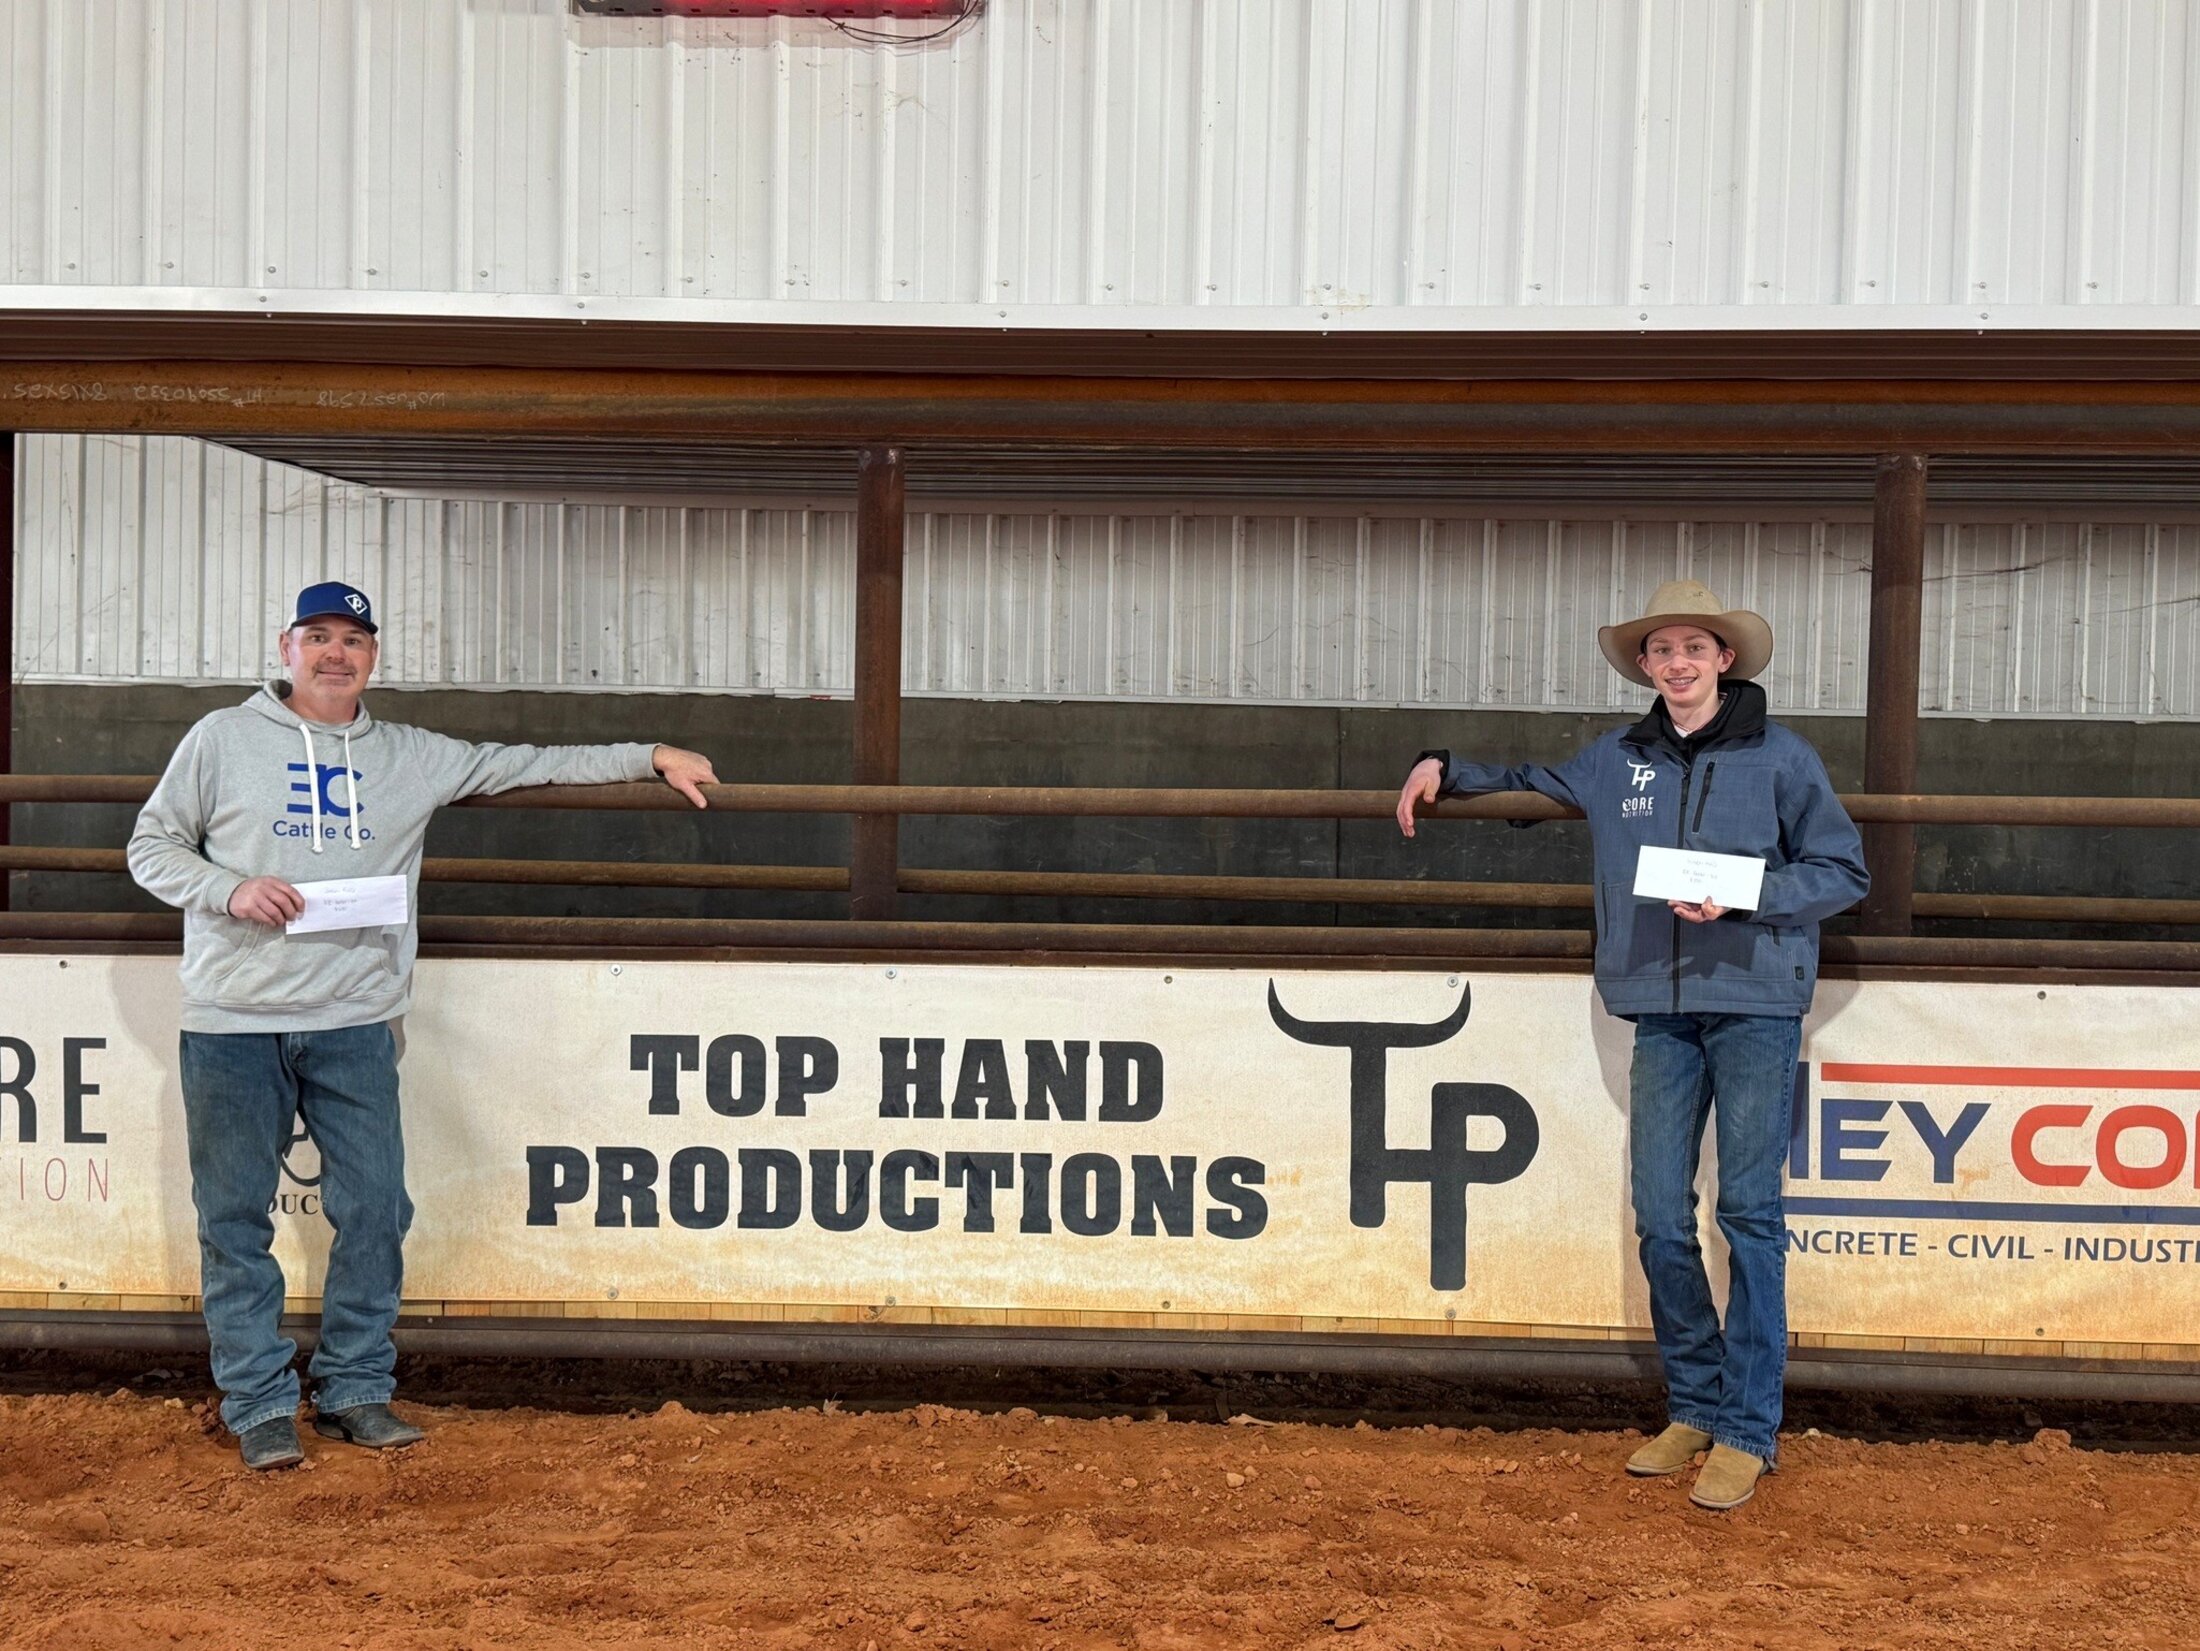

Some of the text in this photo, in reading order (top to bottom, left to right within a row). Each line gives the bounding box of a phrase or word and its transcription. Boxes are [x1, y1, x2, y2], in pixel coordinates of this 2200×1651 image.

[1622, 796, 1655, 812] CORE
[629, 1033, 1166, 1123] TOP HAND
[2011, 1103, 2200, 1189] CO
[525, 1145, 1269, 1240] PRODUCTIONS
[1947, 1233, 2035, 1260] CIVIL
[2064, 1237, 2200, 1264] INDUST
